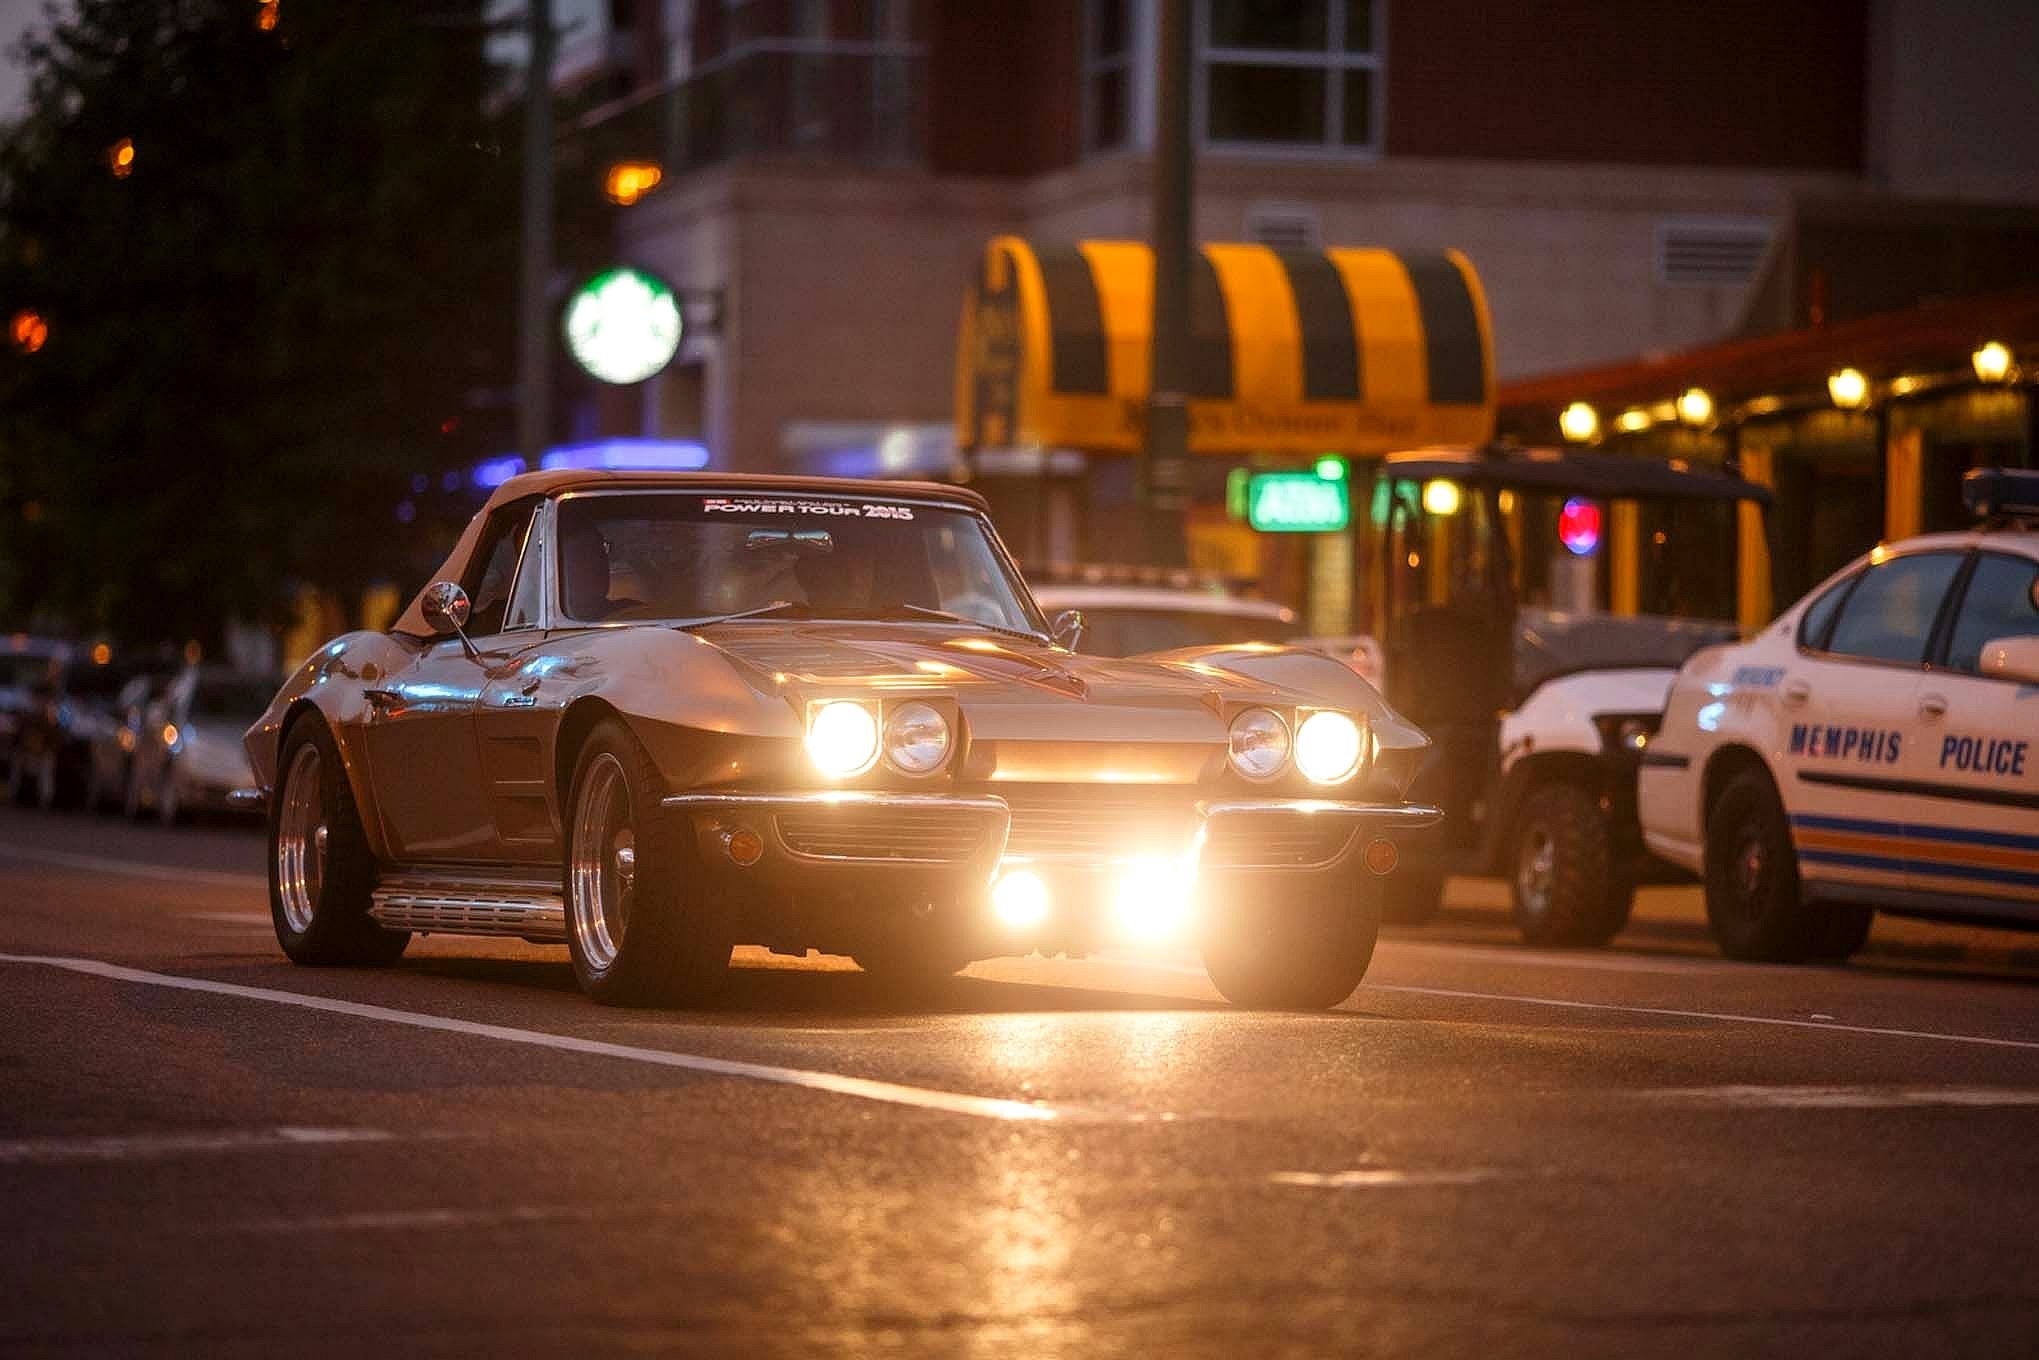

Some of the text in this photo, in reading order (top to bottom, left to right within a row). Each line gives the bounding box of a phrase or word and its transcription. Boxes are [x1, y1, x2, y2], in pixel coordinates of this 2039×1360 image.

[703, 504, 914, 520] POWER TOUR 2015
[1790, 724, 2029, 776] MEMPHIS POLICE
